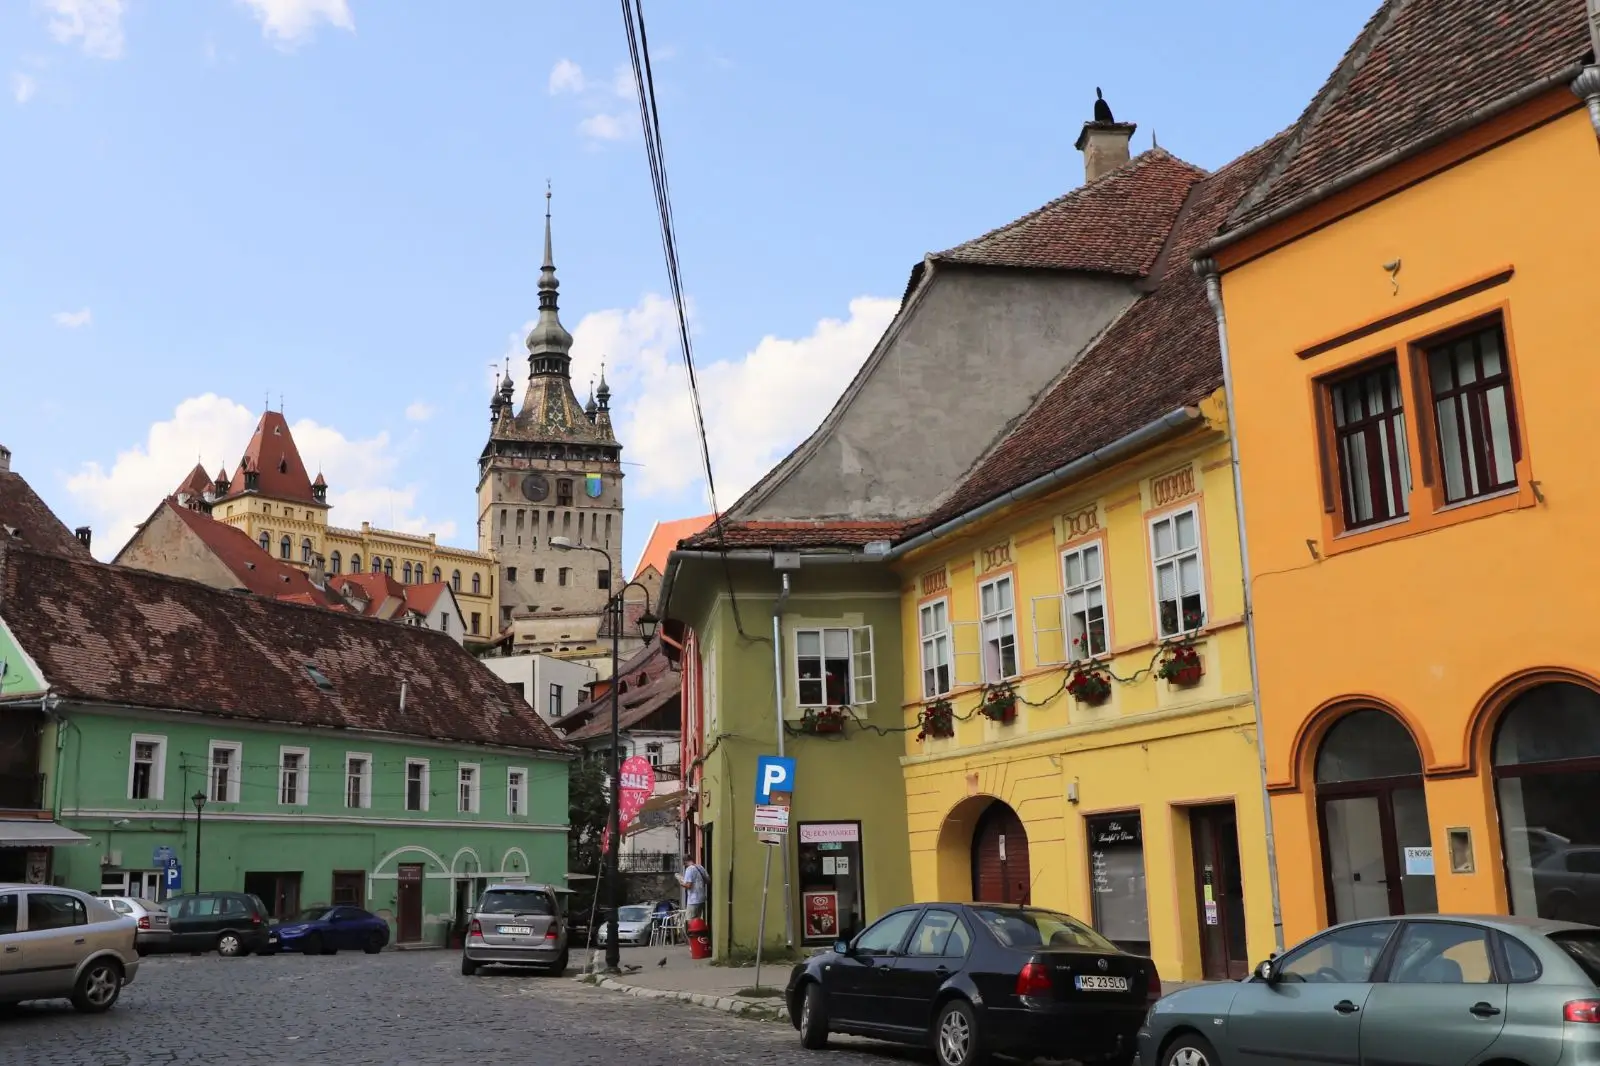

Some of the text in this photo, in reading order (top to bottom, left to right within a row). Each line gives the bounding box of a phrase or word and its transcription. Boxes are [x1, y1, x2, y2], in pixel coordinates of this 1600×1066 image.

[620, 773, 649, 790] SALE
[763, 764, 787, 795] P
[801, 829, 856, 839] QUEEN MARKET
[168, 869, 178, 885] P
[1081, 976, 1126, 989] MS 23 SLO
